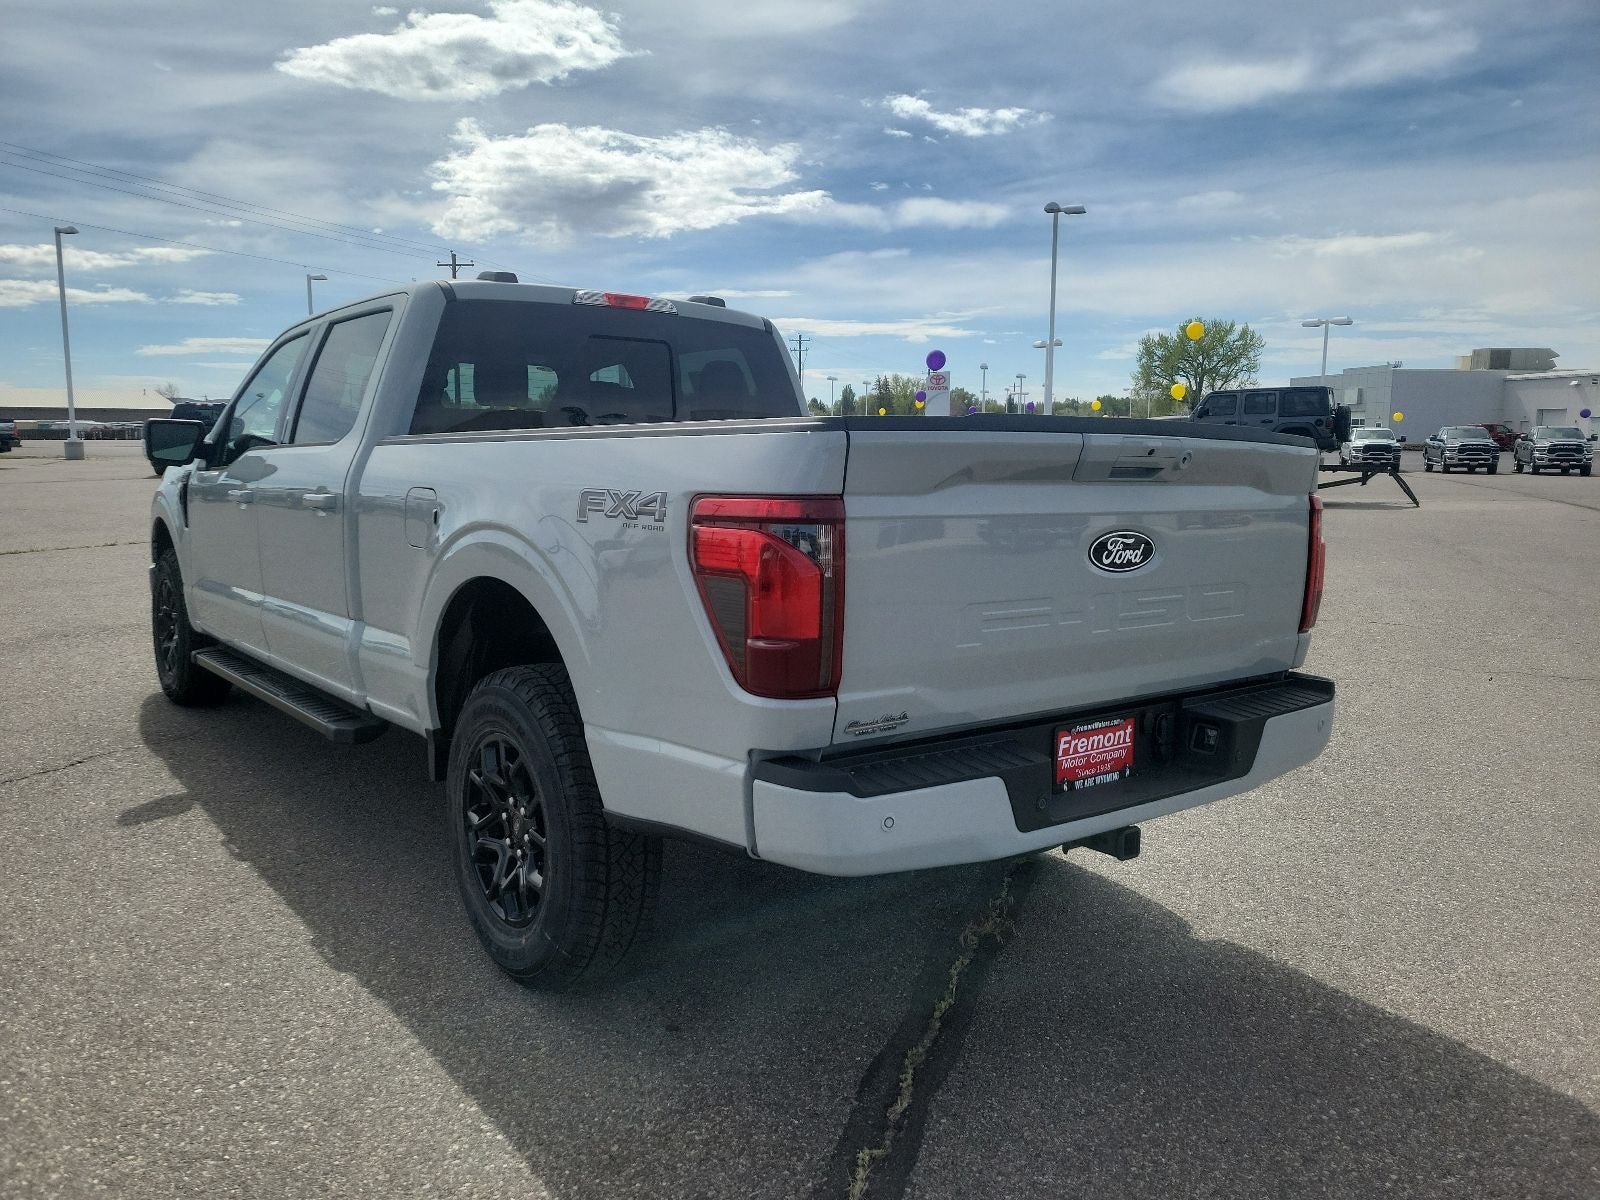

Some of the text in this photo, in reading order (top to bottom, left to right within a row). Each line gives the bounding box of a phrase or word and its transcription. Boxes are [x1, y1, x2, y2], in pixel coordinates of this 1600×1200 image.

[576, 488, 668, 523] FX4
[641, 524, 665, 532] ROAD
[1102, 537, 1145, 564] Ford
[1058, 725, 1132, 756] Fremont
[1062, 748, 1128, 769] Motor Company
[1074, 779, 1084, 790] WE
[1084, 776, 1095, 788] ARE
